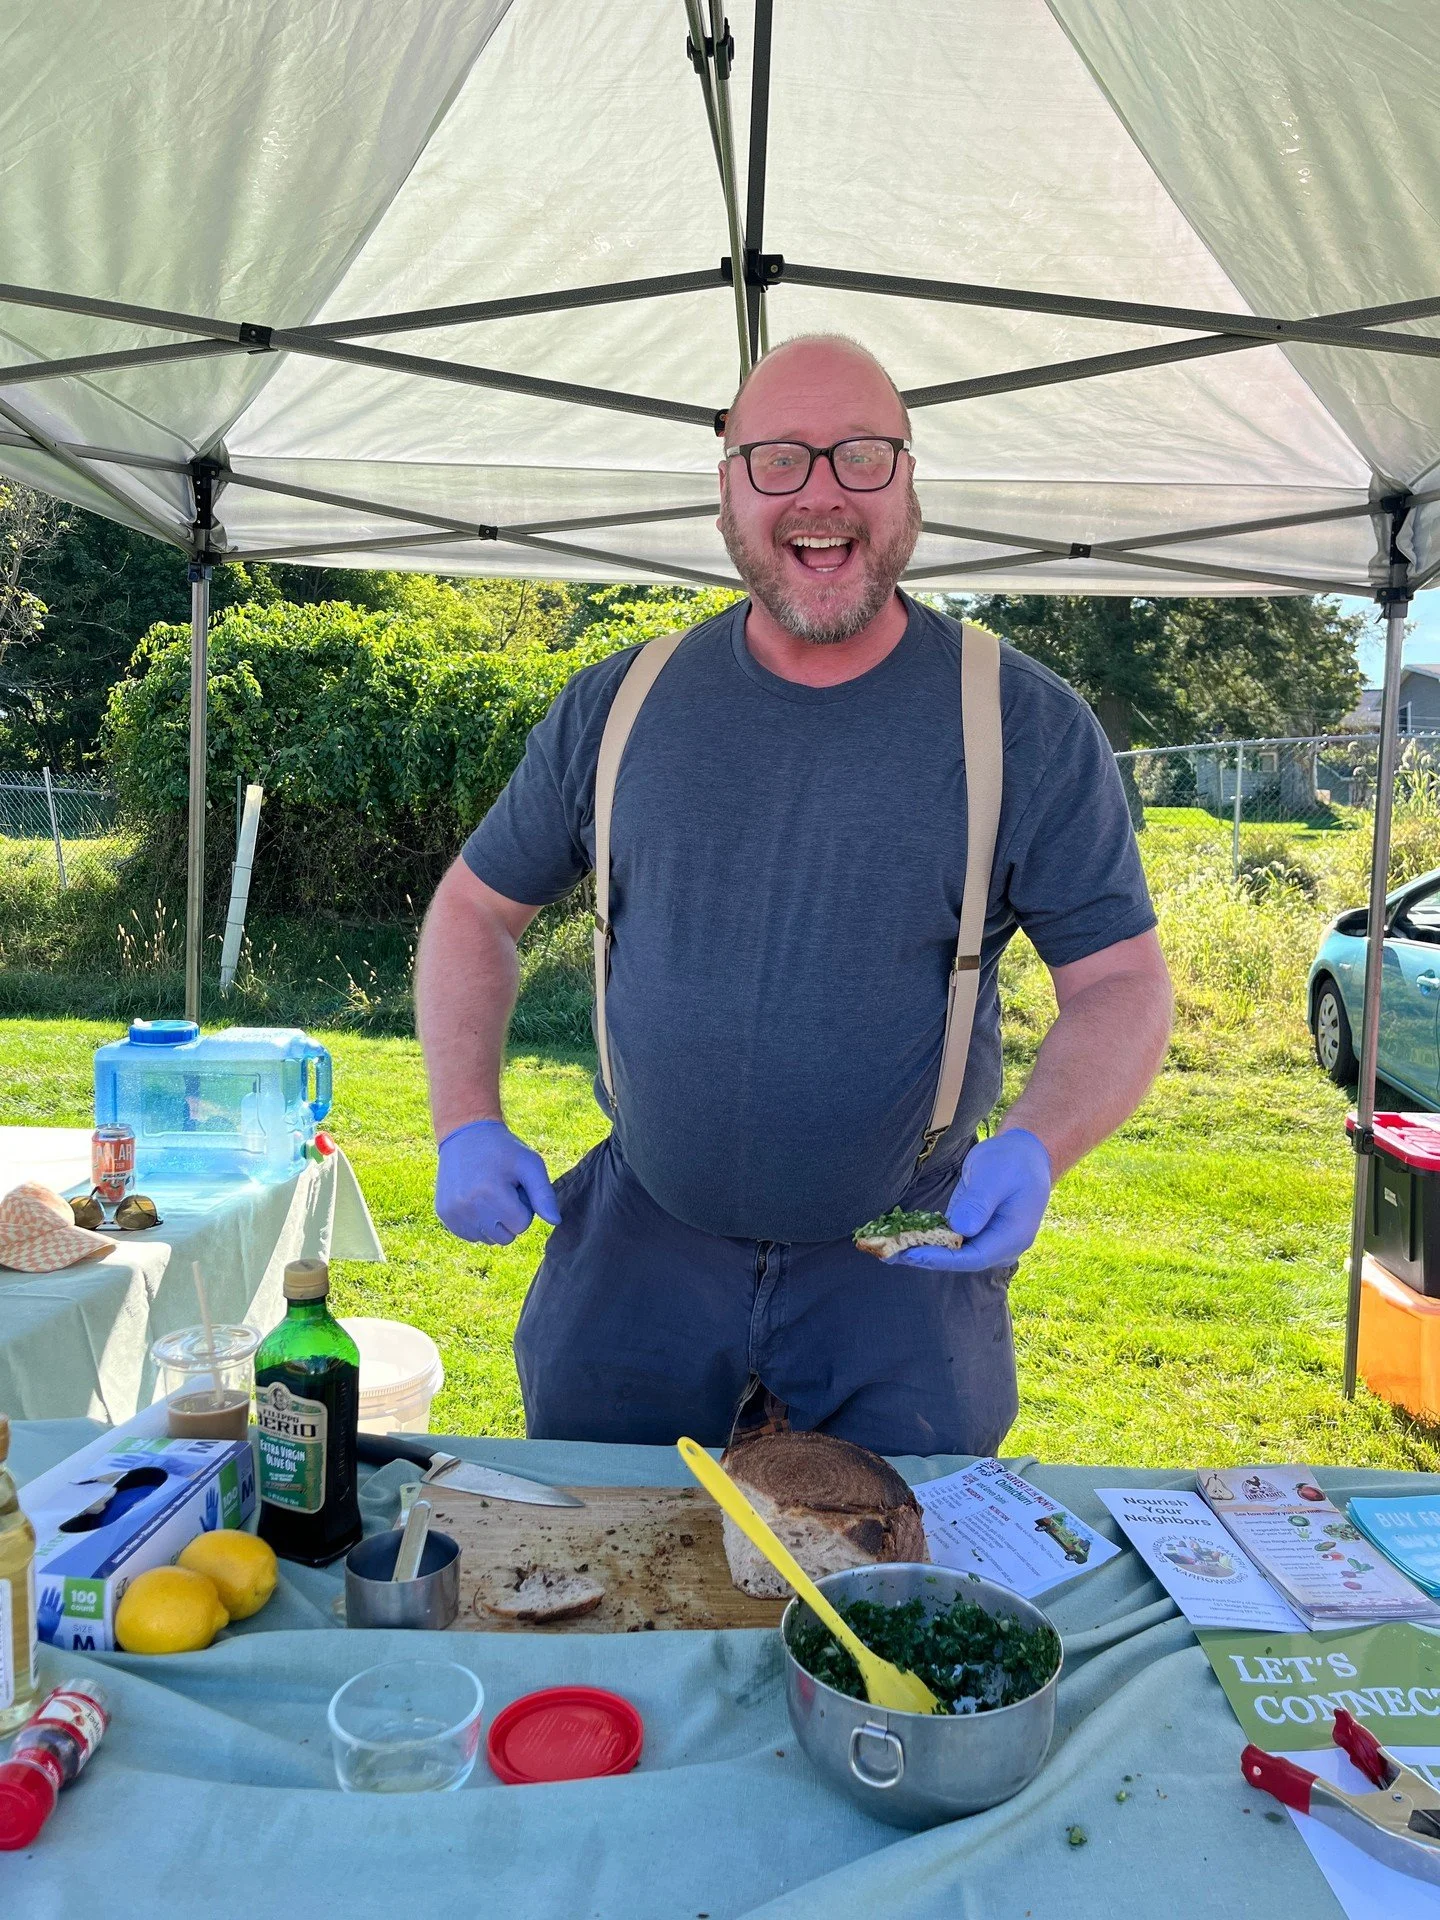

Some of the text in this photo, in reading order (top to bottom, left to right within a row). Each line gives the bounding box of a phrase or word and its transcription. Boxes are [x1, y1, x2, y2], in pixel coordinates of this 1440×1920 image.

[263, 1408, 299, 1423] FILIPPO
[260, 1439, 280, 1455] EXTRA
[280, 1446, 306, 1462] VIRGIN
[266, 1453, 298, 1473] OLIVE OIL
[1123, 1497, 1188, 1507] Nourish
[1143, 1506, 1181, 1515] Your
[1124, 1514, 1211, 1526] Neighbors
[1374, 1512, 1418, 1528] BUY
[1182, 1535, 1214, 1547] FOOD
[71, 1590, 98, 1604] 100
[71, 1604, 96, 1613] count
[73, 1624, 93, 1632] SIZE
[73, 1634, 96, 1651] M
[1229, 1652, 1358, 1684] LET'S
